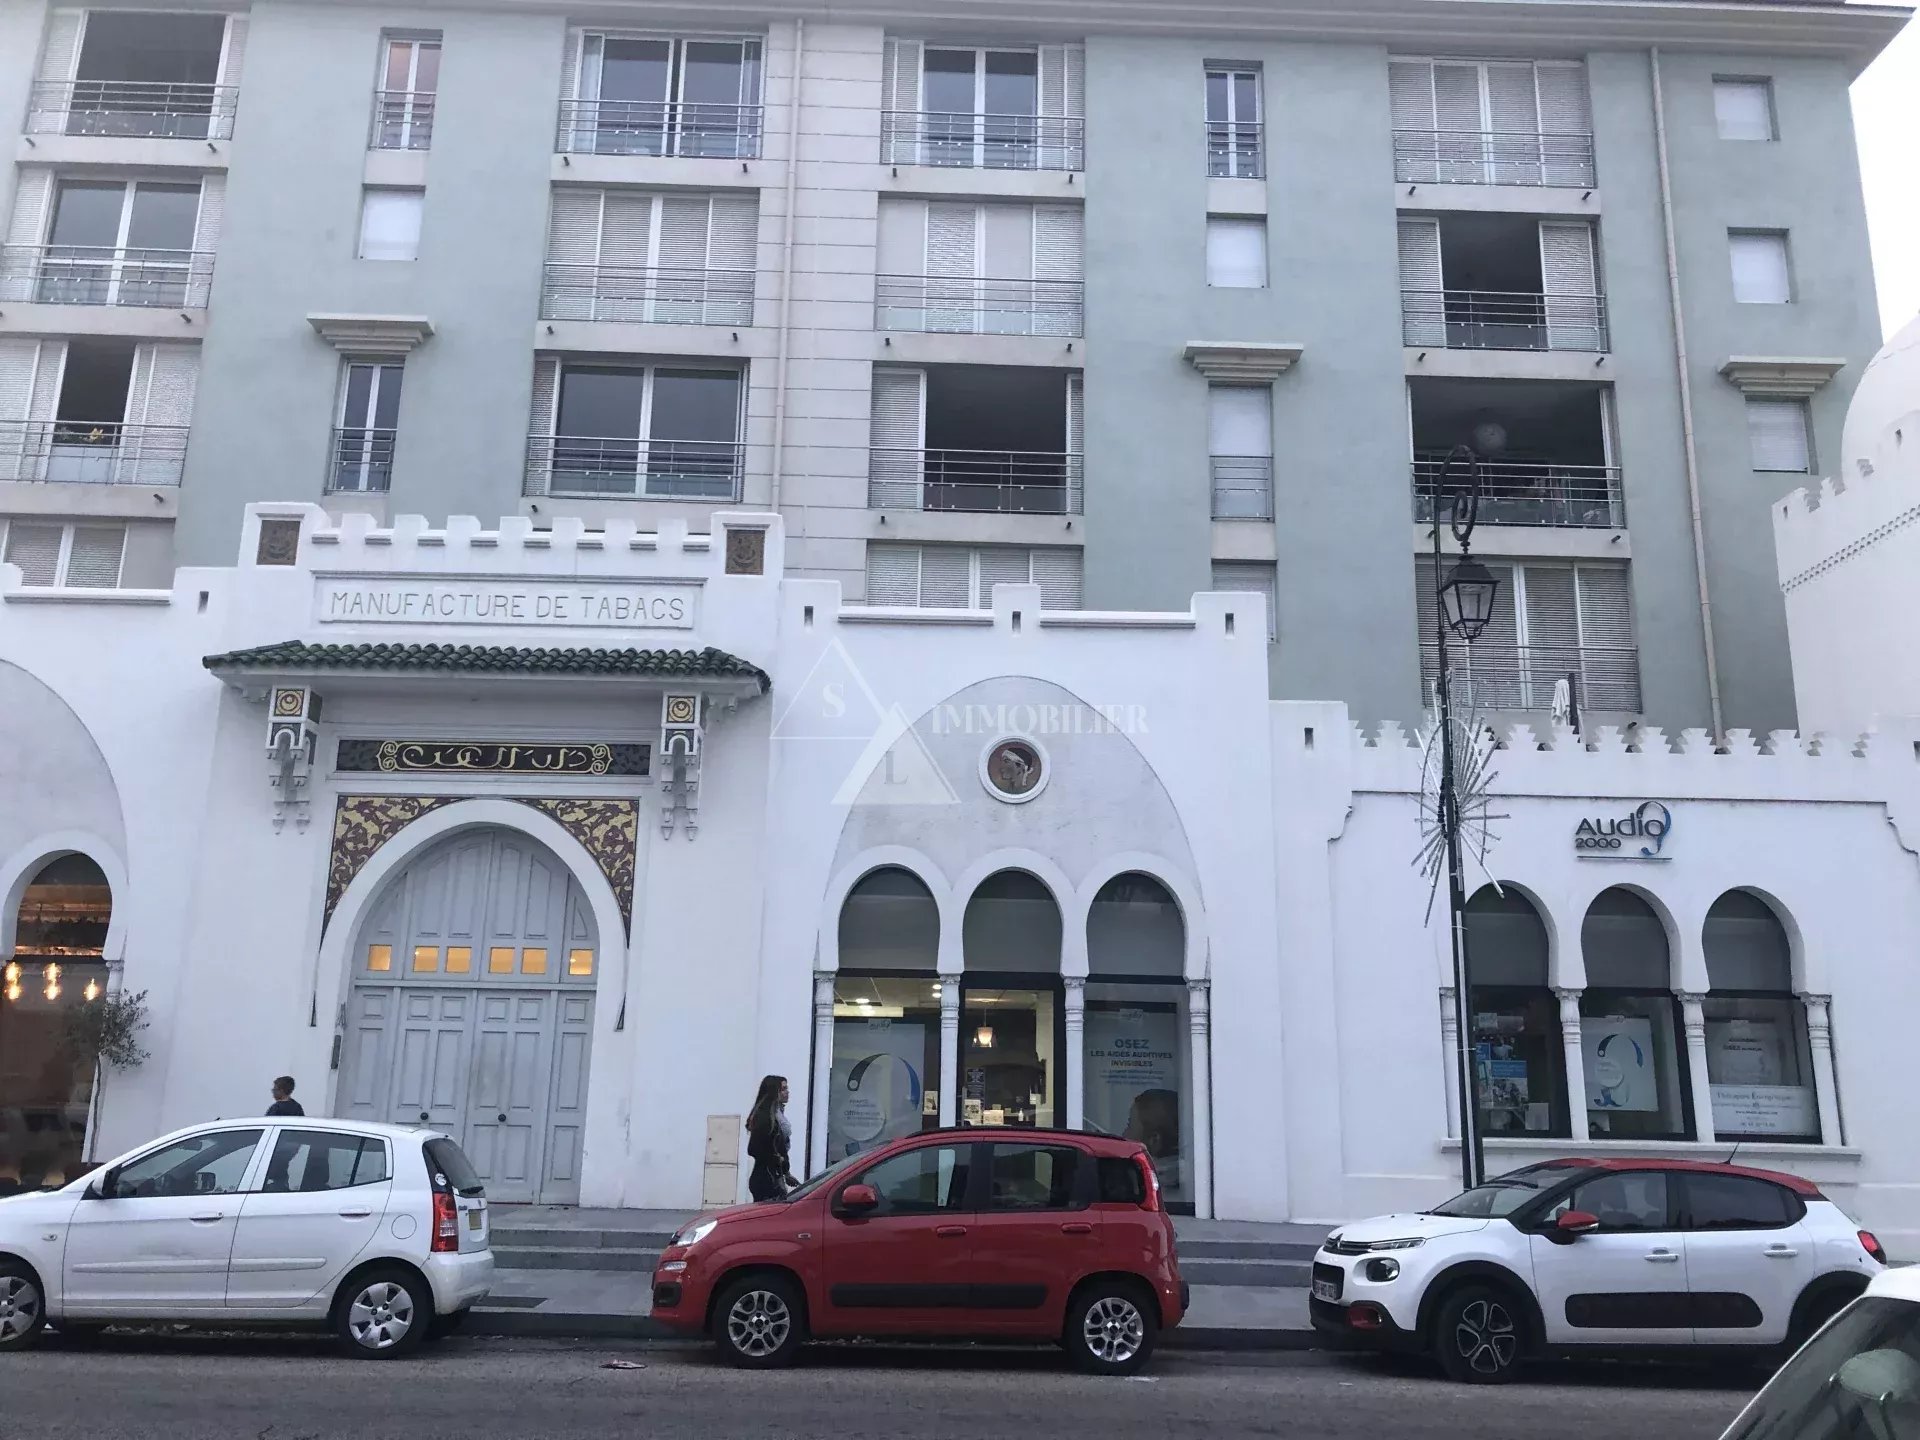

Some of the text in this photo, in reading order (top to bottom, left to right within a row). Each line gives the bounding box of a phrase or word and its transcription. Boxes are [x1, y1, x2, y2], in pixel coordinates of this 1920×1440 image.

[331, 591, 684, 621] MANUFACTURE DE TABACS
[1575, 837, 1622, 849] 2000
[1114, 1039, 1149, 1049] OSEZ
